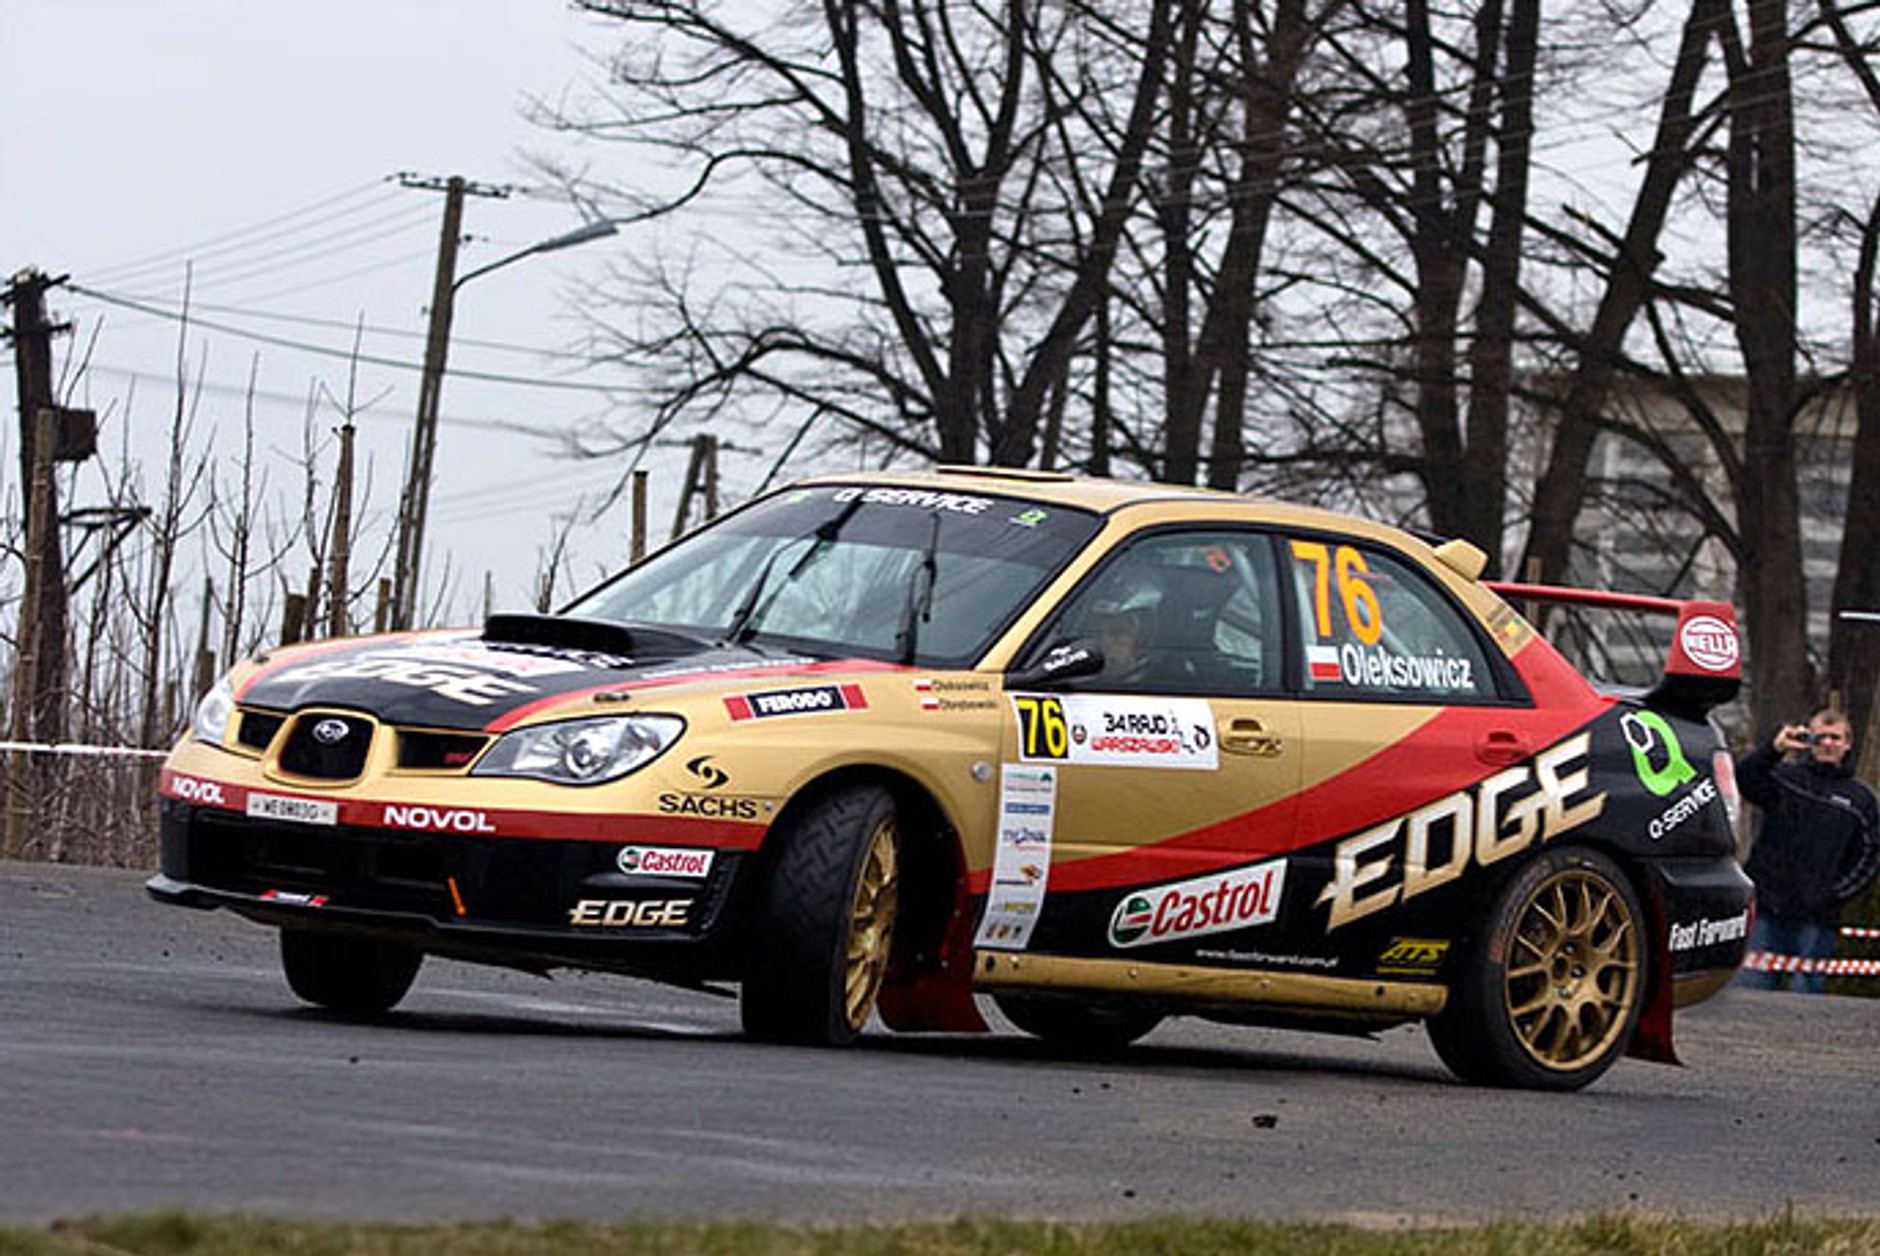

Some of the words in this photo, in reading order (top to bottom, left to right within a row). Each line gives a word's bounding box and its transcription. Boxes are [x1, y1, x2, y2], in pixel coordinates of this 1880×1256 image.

[1289, 539, 1383, 646] 76
[1341, 643, 1475, 689] Oleksowicz
[756, 689, 832, 714] FERODO
[1016, 698, 1068, 757] 76
[1103, 711, 1126, 733] 34
[172, 776, 226, 804] NOVOL
[383, 805, 497, 832] NOVOL
[658, 793, 757, 820] SACHS
[1311, 731, 1608, 935] EDGE
[640, 850, 708, 874] Castrol
[568, 898, 695, 927] EDGE
[1151, 869, 1274, 937] Castrol
[1668, 921, 1697, 952] Fast
[1697, 909, 1749, 947] Forward
